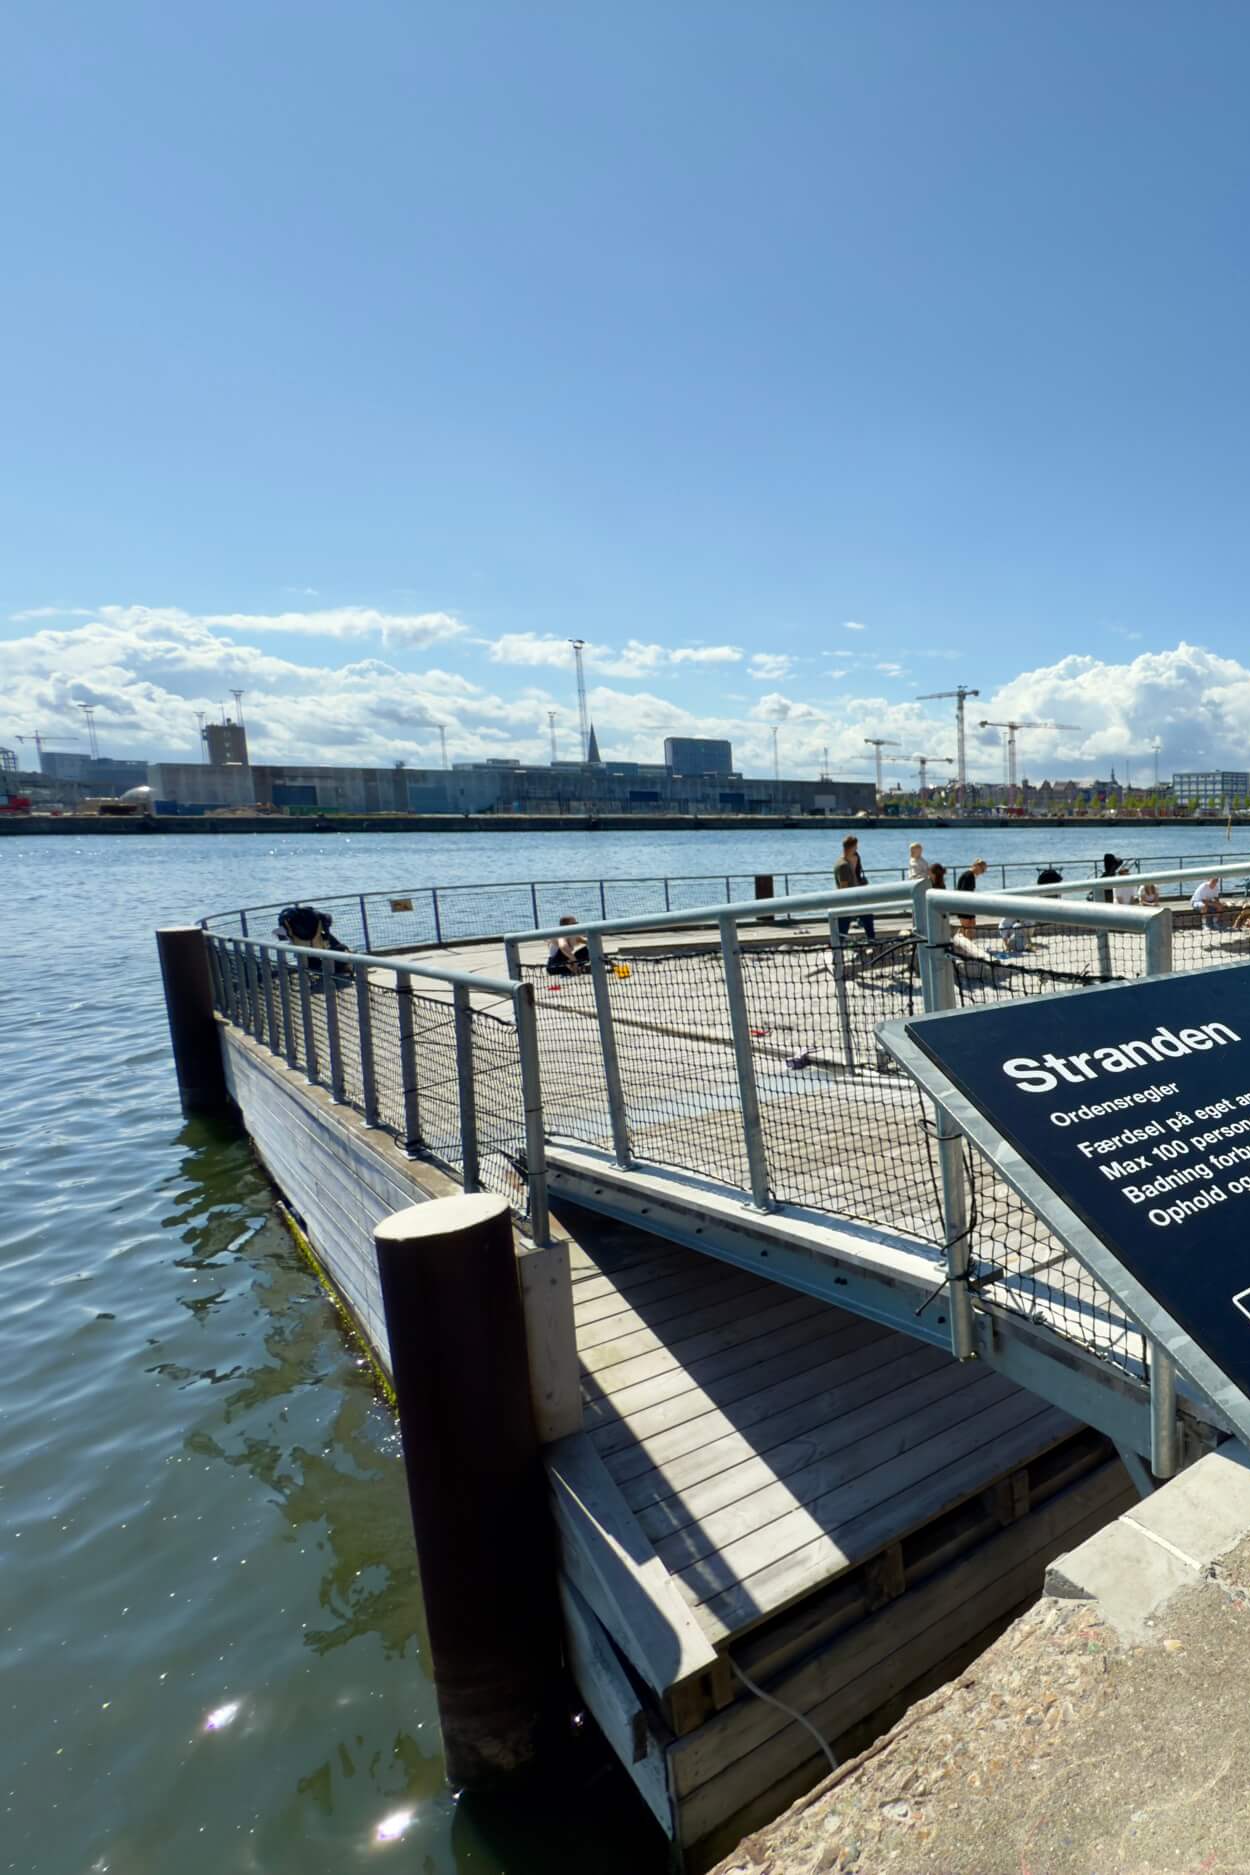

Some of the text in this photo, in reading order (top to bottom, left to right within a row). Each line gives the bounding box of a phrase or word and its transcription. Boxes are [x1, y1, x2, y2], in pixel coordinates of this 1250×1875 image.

[1002, 1022, 1242, 1093] Stranden
[1050, 1081, 1180, 1127] Ordensregler
[1077, 1120, 1166, 1158] Færdsel
[1165, 1111, 1194, 1132] på
[1194, 1098, 1236, 1119] eget
[1099, 1155, 1153, 1181] Max
[1152, 1139, 1190, 1162] 100
[1121, 1162, 1214, 1204] Badning
[1148, 1184, 1228, 1227] Ophold
